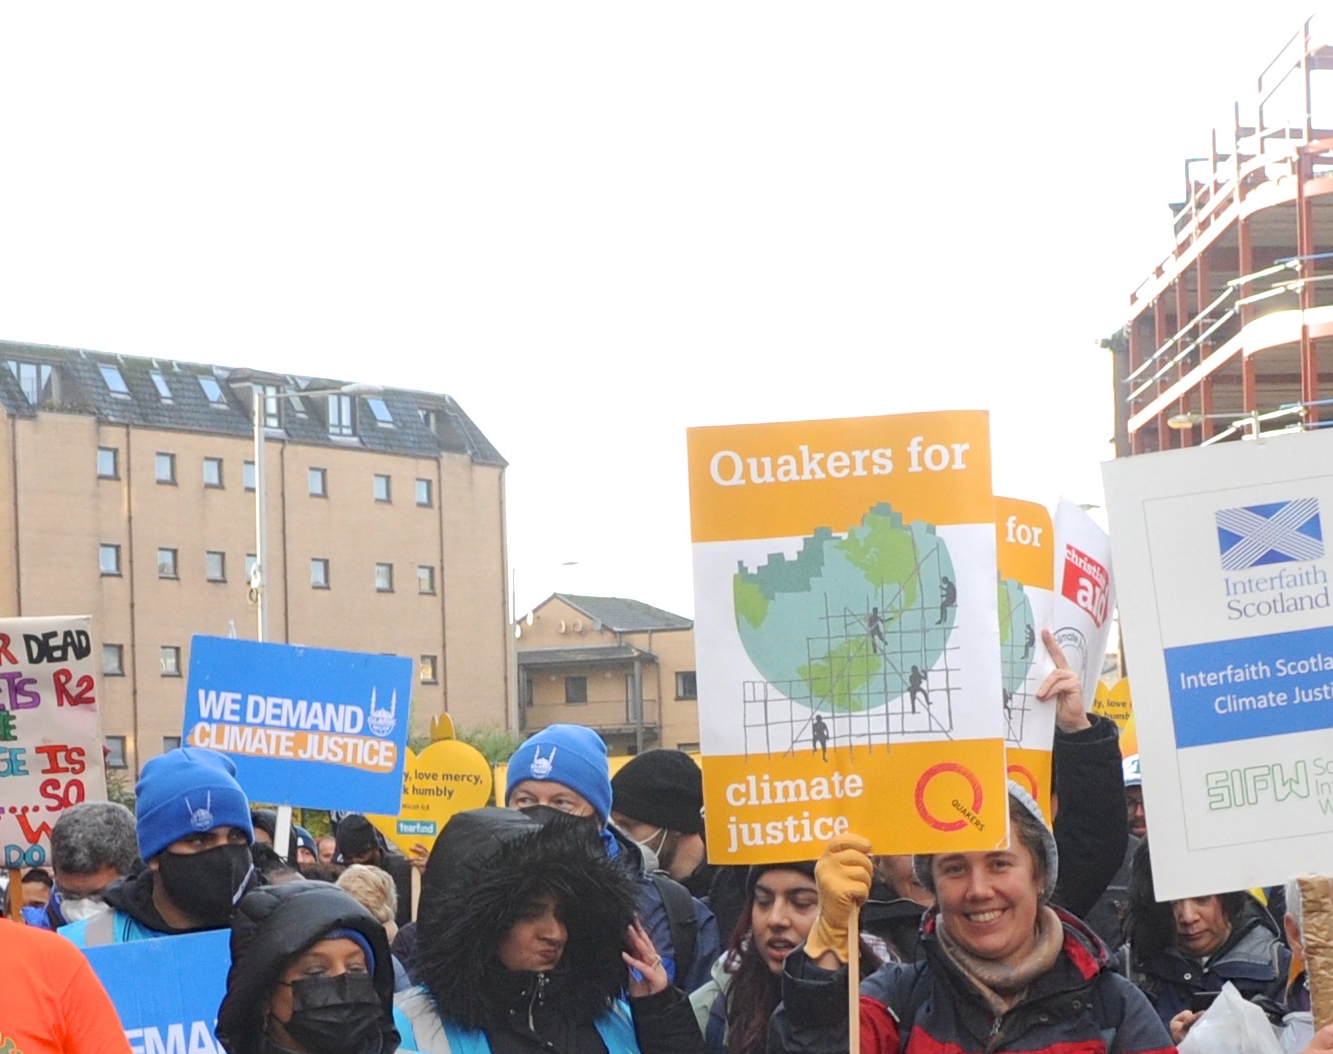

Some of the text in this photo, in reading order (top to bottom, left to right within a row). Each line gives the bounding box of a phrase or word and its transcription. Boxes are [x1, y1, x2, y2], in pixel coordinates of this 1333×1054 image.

[710, 437, 969, 486] Quakers for
[1005, 515, 1043, 547] for
[1224, 564, 1328, 597] Interfaith
[1227, 586, 1331, 620] Scotland
[23, 630, 91, 664] DEAD
[53, 668, 96, 707] R2
[1180, 661, 1271, 690] Interfaith
[198, 688, 243, 722] WE
[246, 694, 365, 734] DEMAND
[1214, 690, 1288, 714] Climate
[35, 745, 86, 774] IS
[193, 722, 395, 767] CLIMATE JUSTICE
[412, 784, 454, 799] humbly
[414, 769, 438, 781] love
[442, 772, 483, 785] mercy,
[726, 770, 864, 807] climate
[1205, 760, 1310, 811] SIFW
[39, 779, 85, 812] SO
[399, 822, 434, 834] tearfund
[951, 798, 985, 832] QUAKERS
[727, 813, 849, 853] justice
[4, 844, 46, 868] DO
